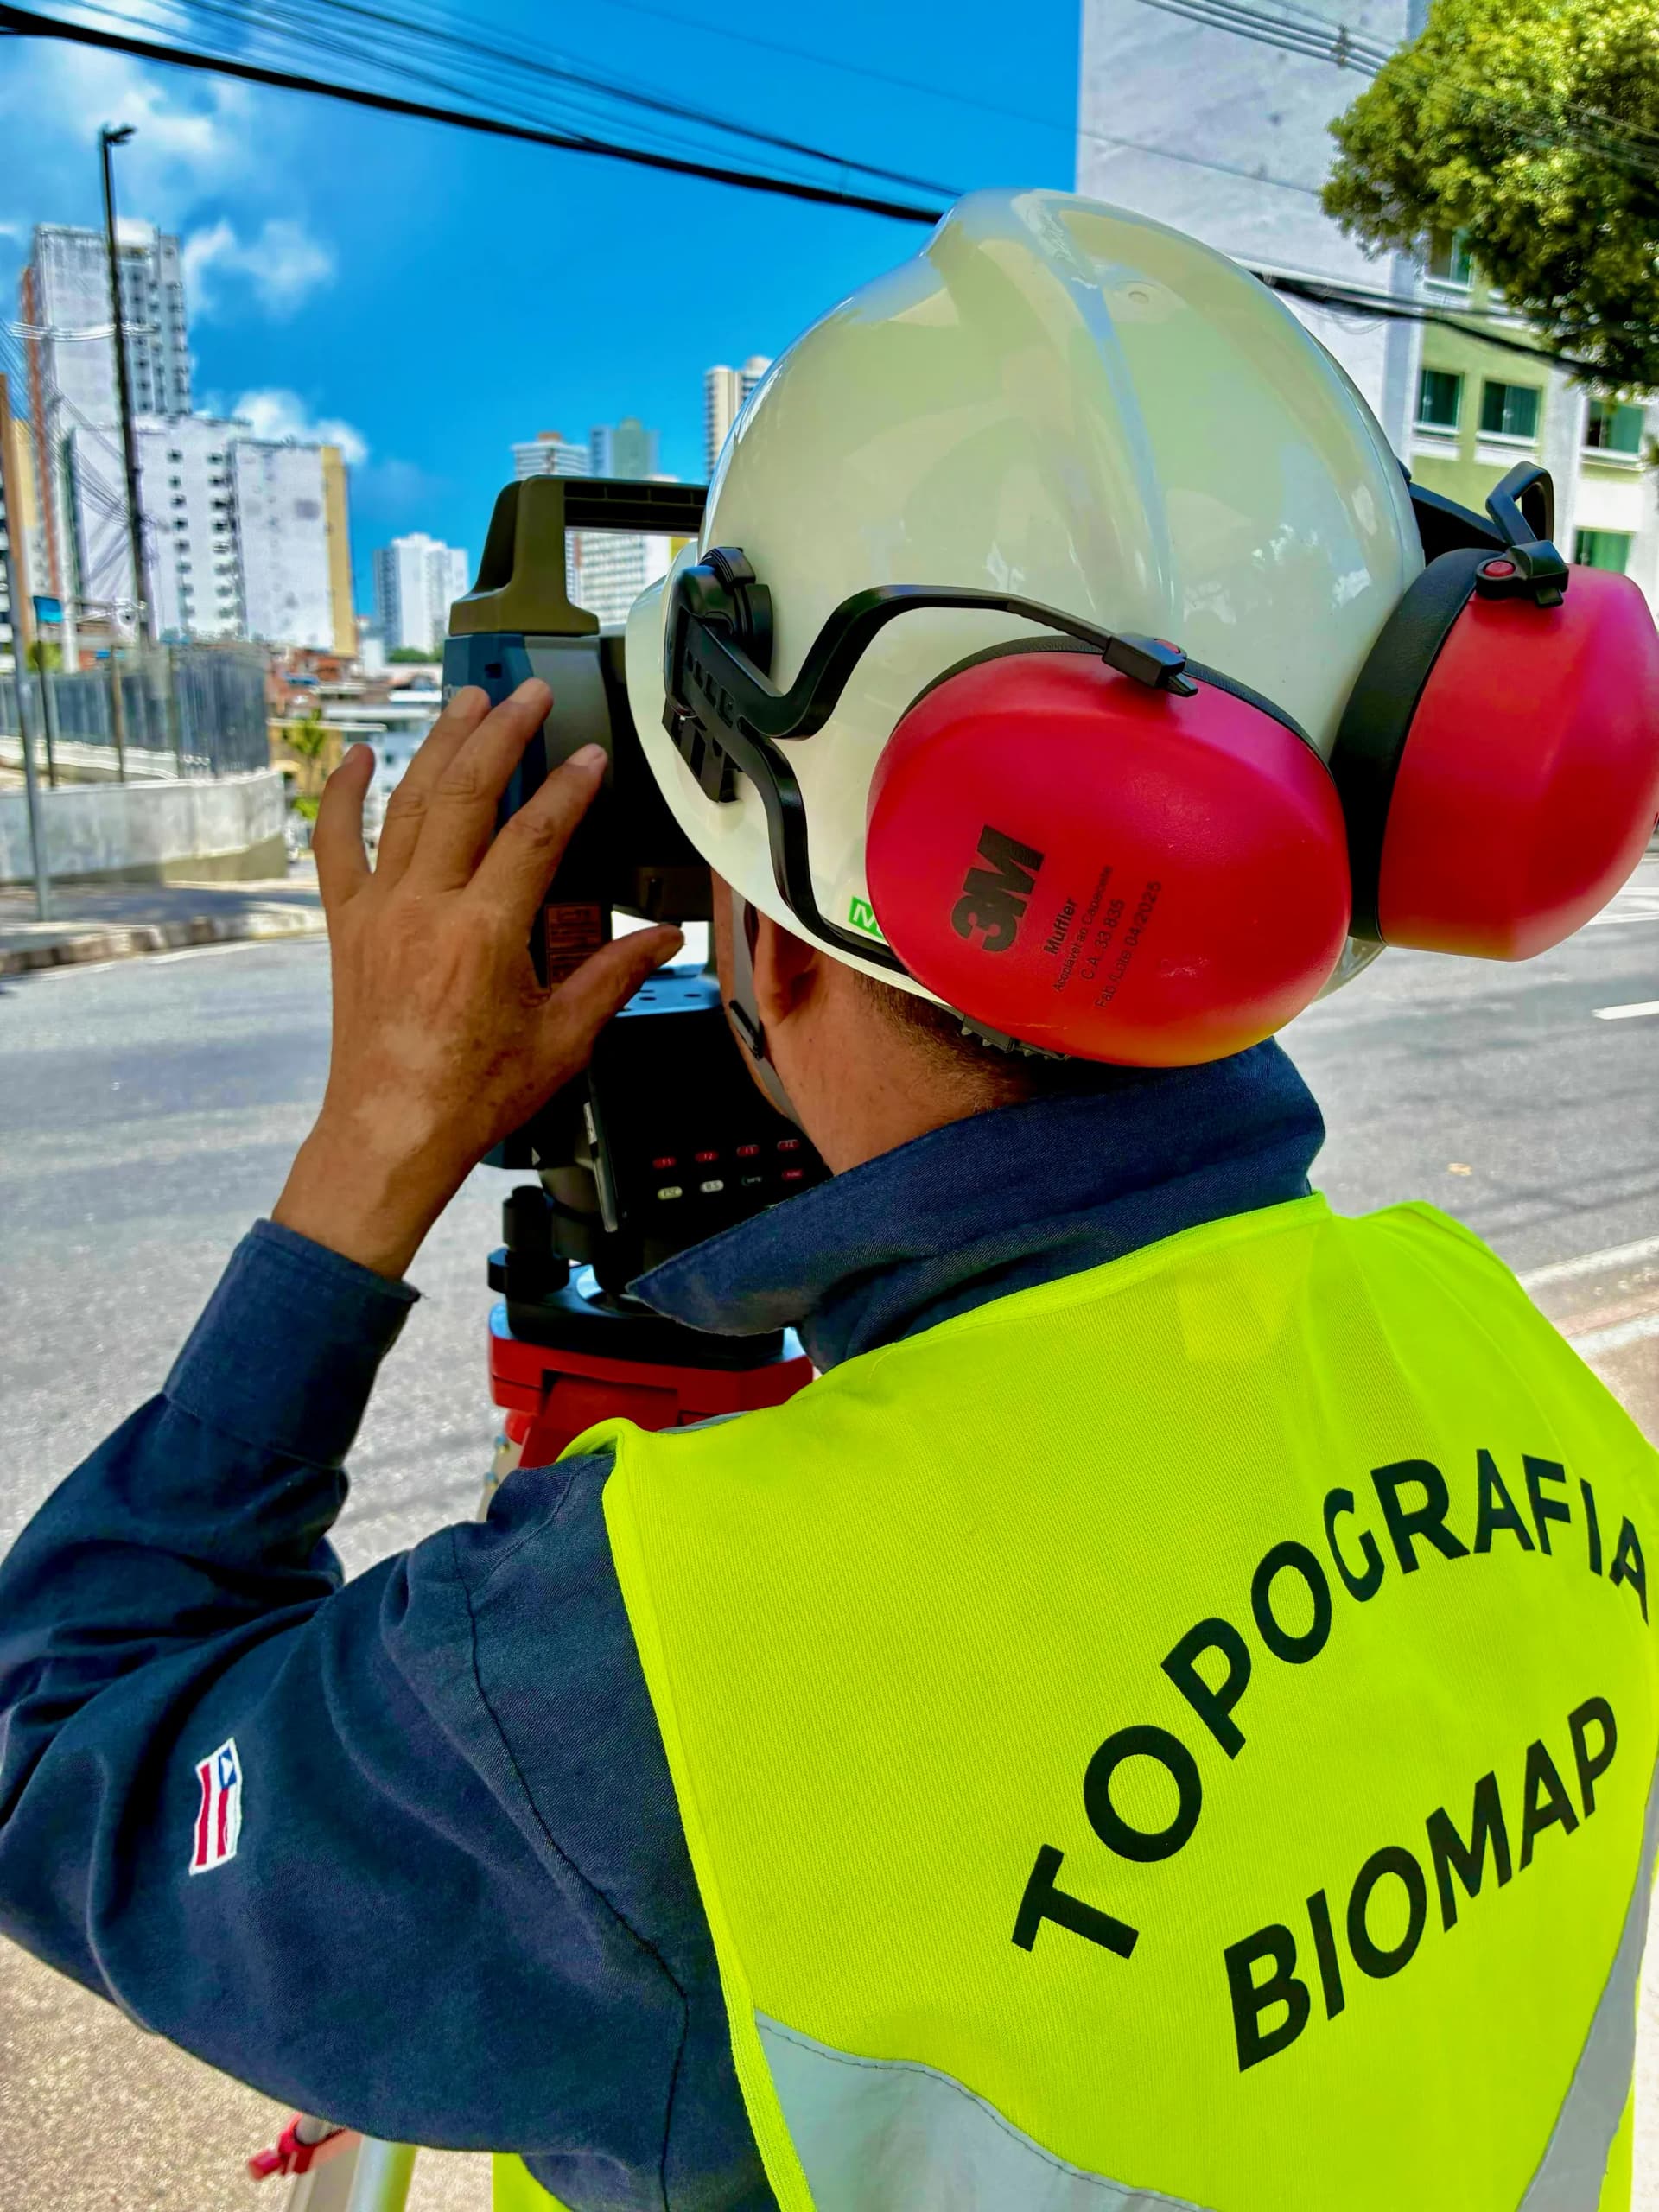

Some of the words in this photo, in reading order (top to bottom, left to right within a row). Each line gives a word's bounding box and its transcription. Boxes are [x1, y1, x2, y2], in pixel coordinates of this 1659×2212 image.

[951, 823, 1046, 952] 3M
[1043, 896, 1077, 955] Muffler
[1012, 1449, 1649, 1960] TOPOGRAFIA
[1224, 1696, 1617, 2073] BIOMAP
